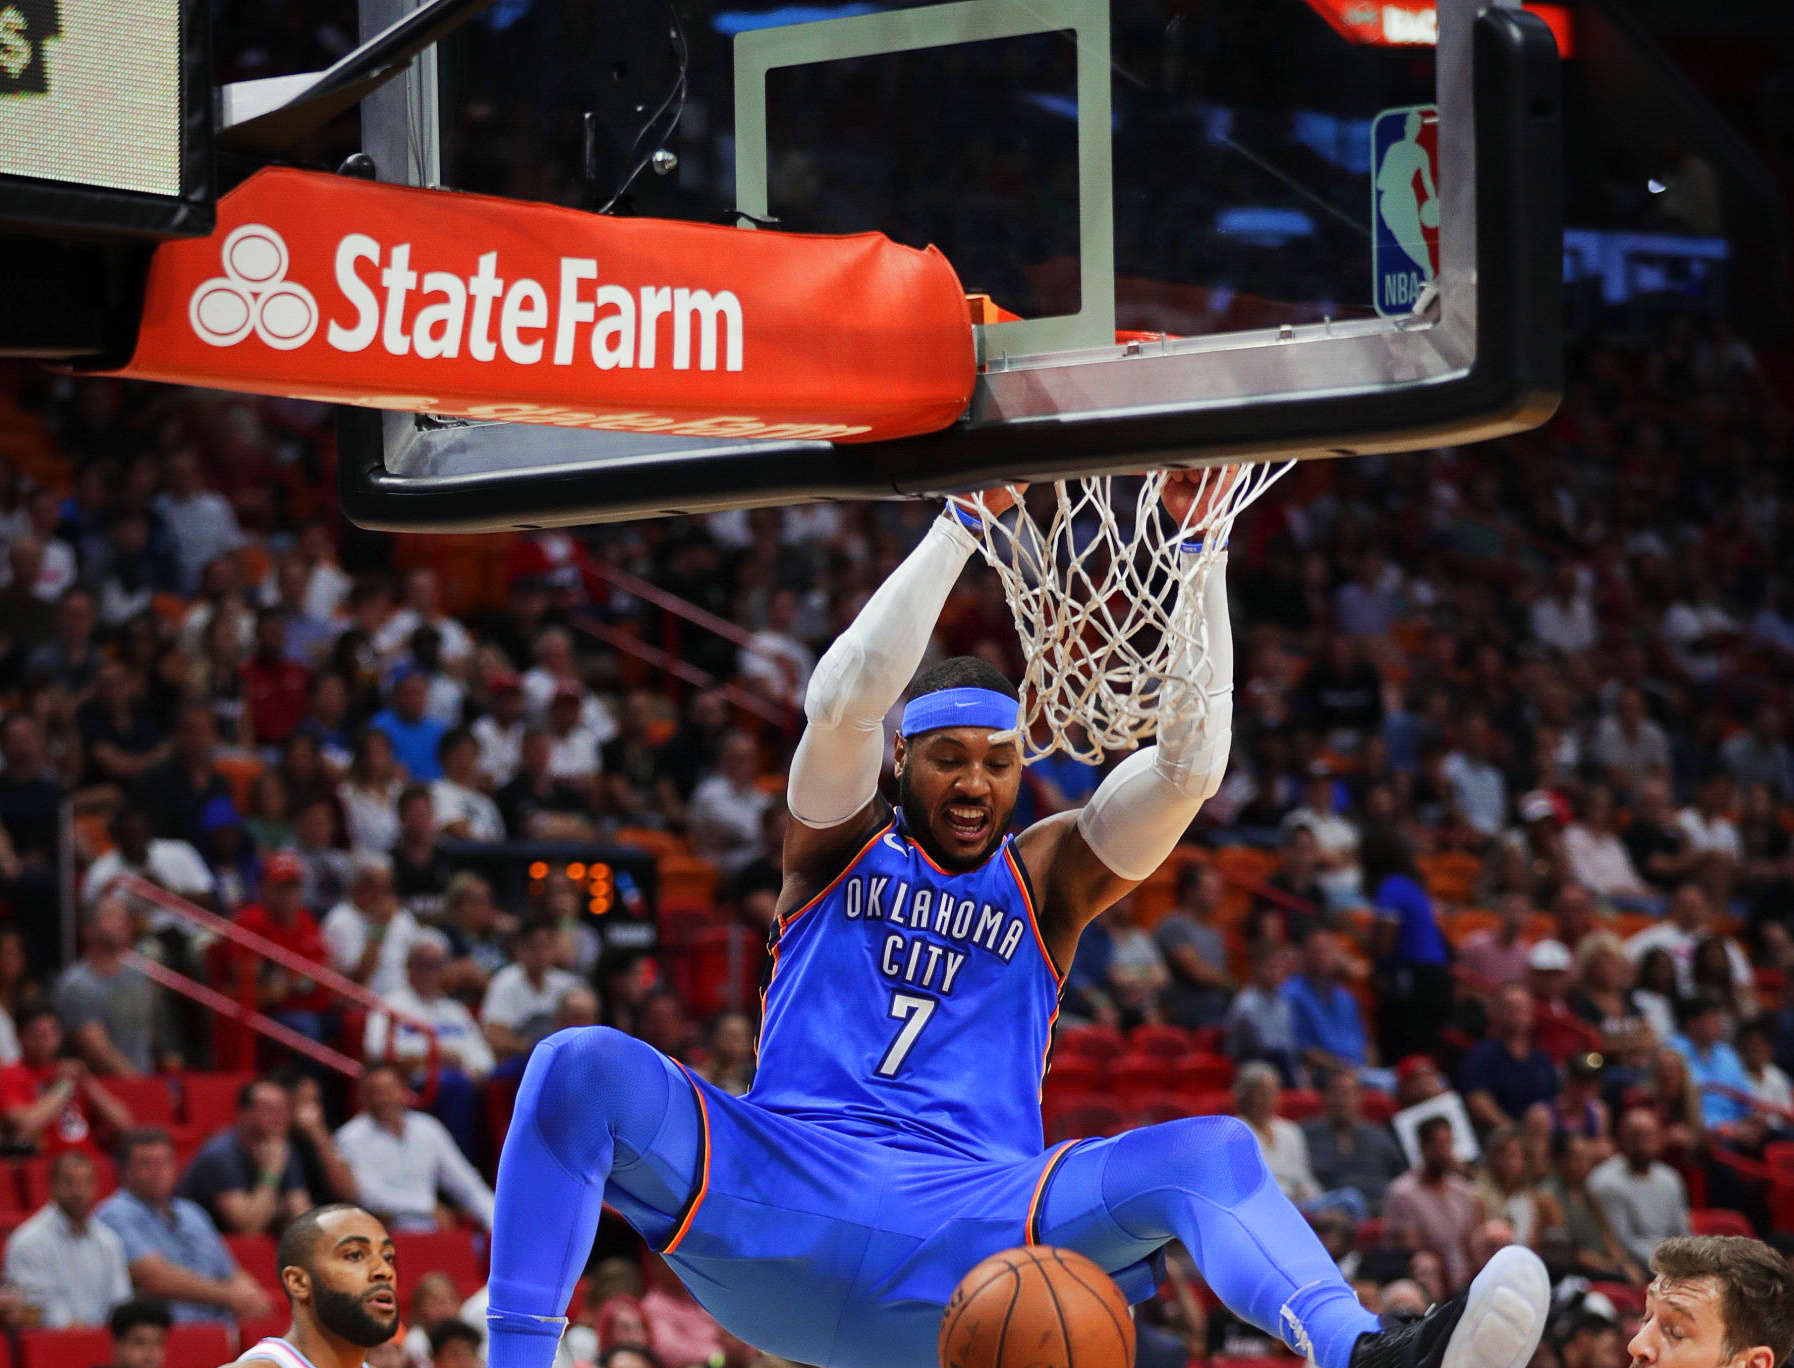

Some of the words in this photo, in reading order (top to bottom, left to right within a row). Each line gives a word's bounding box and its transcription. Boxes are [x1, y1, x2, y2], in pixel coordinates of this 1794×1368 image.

[1385, 271, 1419, 306] NBA
[845, 876, 1025, 964] OKLAHOMA
[881, 934, 965, 994] CITY
[876, 992, 938, 1078] 7
